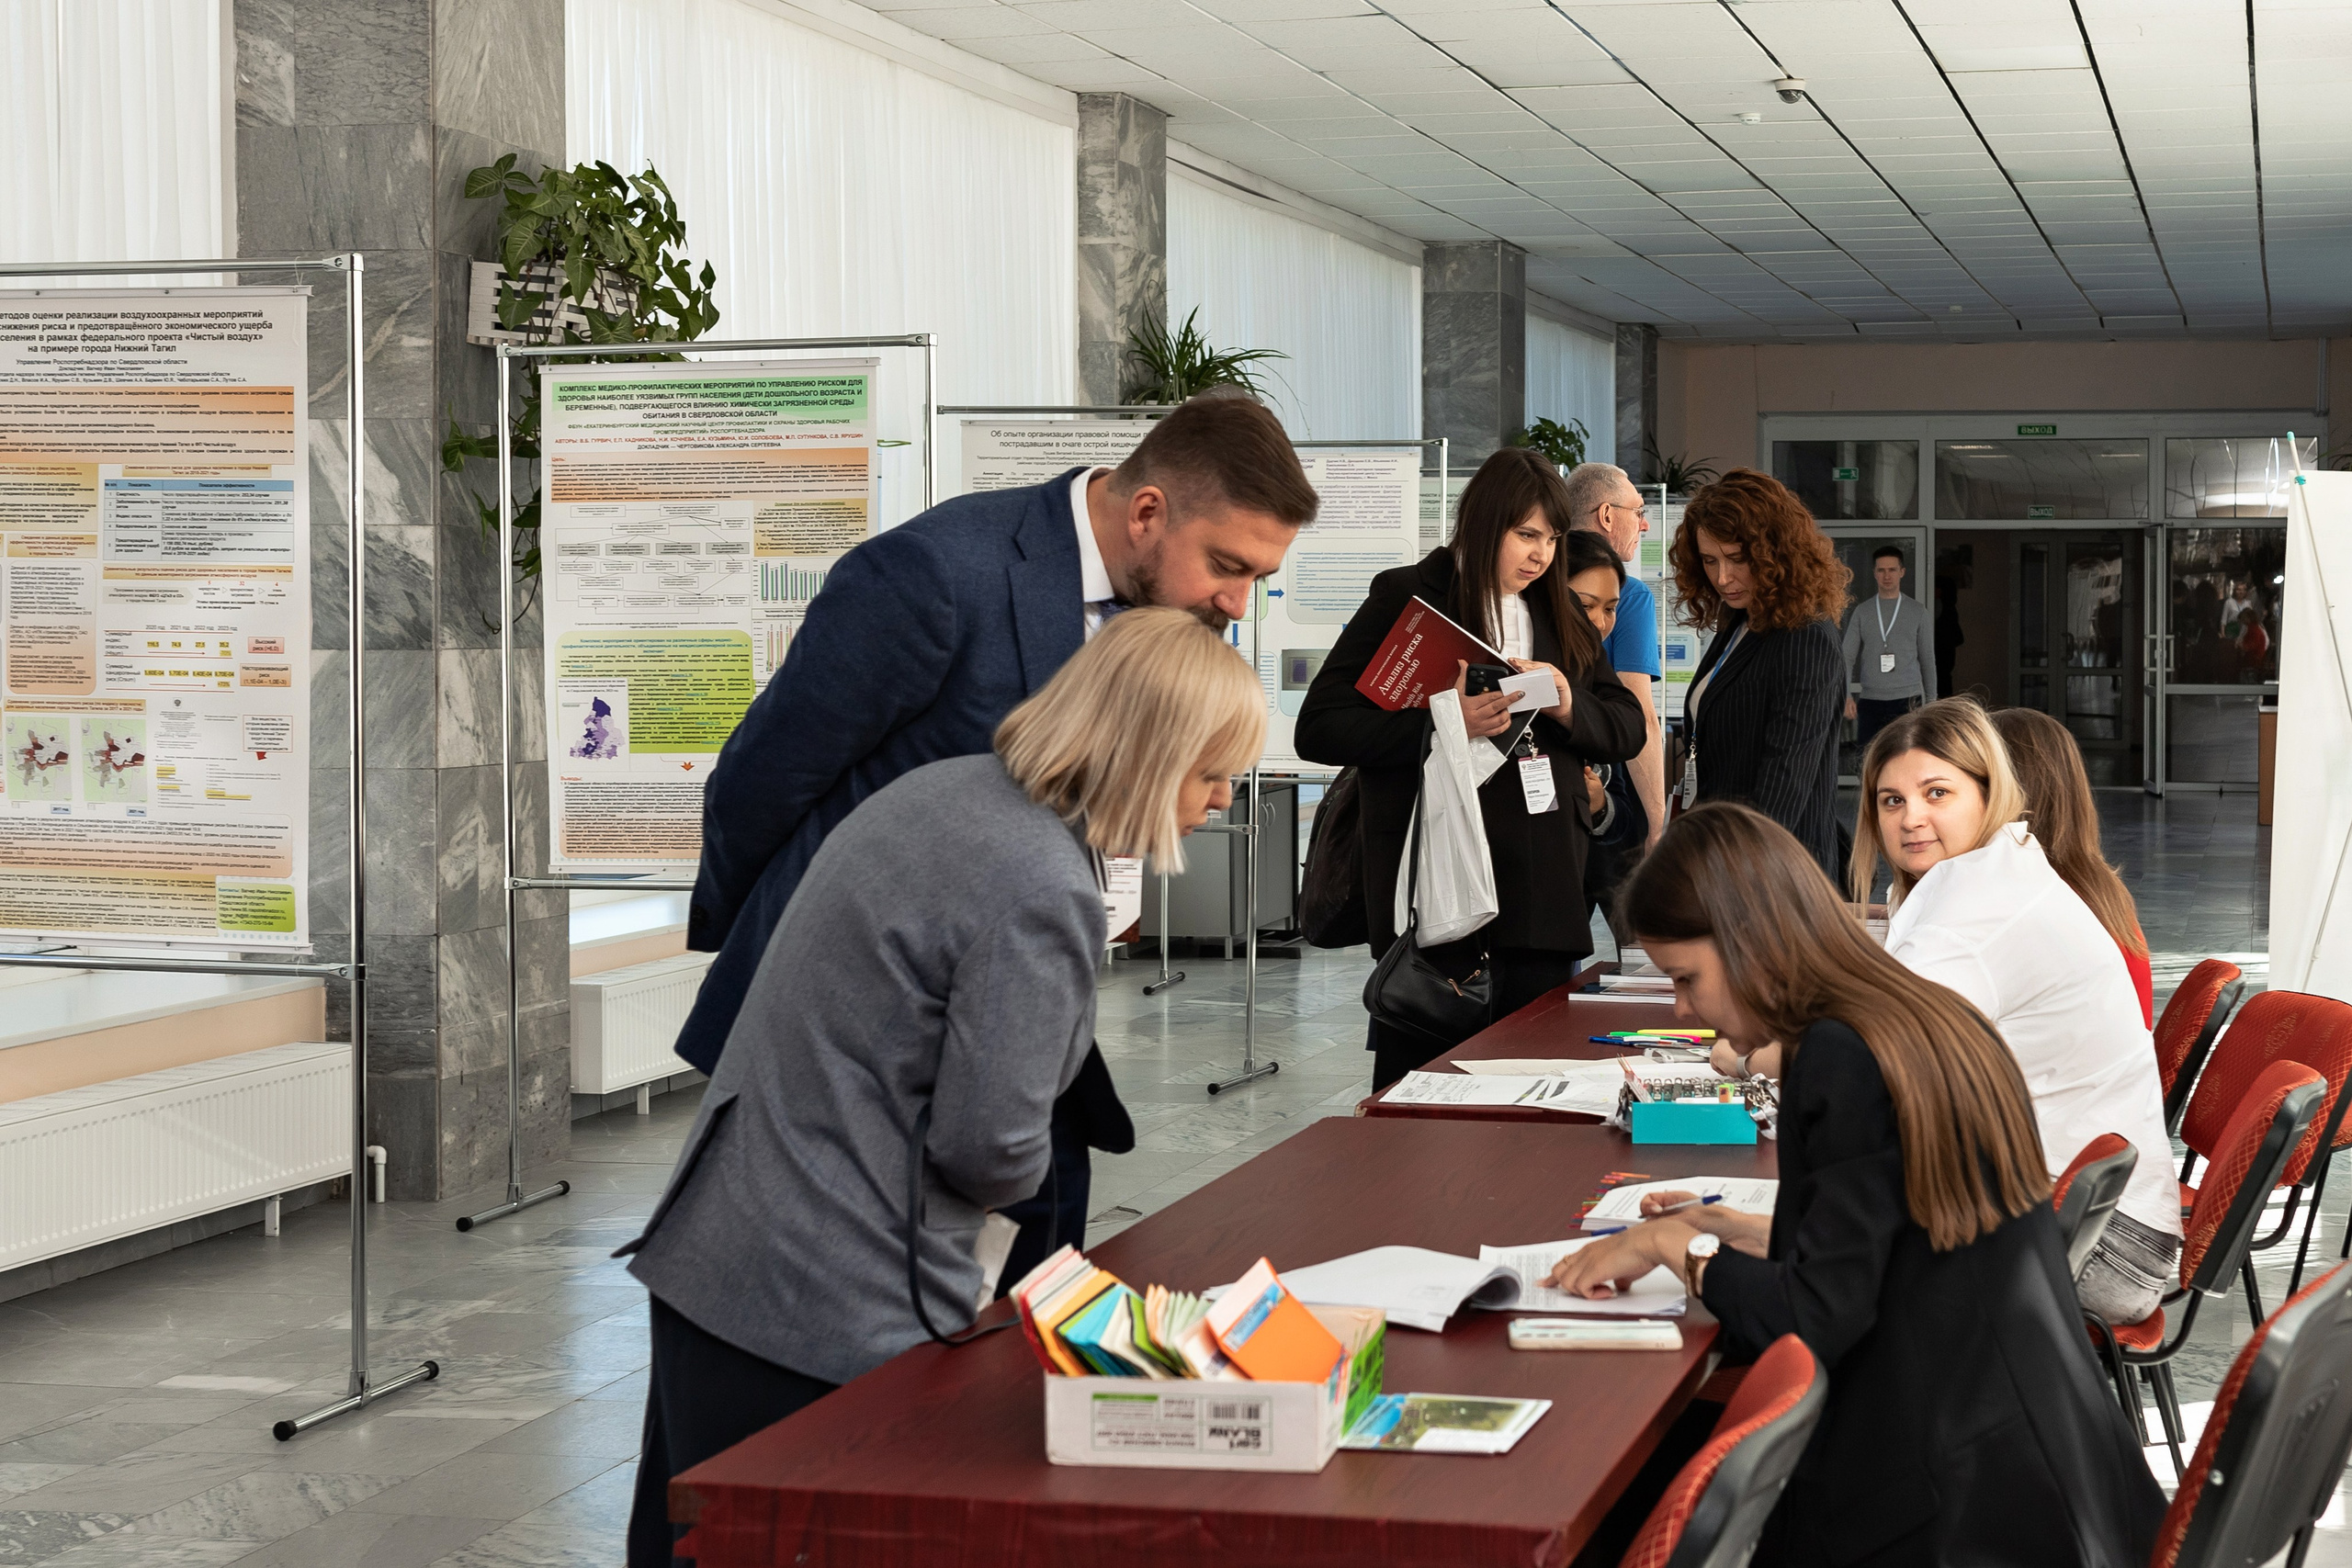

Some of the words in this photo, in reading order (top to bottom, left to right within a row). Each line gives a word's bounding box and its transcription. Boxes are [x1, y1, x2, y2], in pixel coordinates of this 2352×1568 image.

[32, 312, 63, 321] оценки
[65, 311, 118, 321] реализации
[120, 311, 200, 321] воздухоохранных
[203, 310, 264, 320] мероприятий
[42, 323, 67, 332] риска
[77, 321, 163, 332] предотвращённого
[164, 321, 237, 331] экономического
[239, 321, 273, 331] ущерба
[47, 334, 78, 344] рамках
[80, 333, 145, 344] федерального
[148, 333, 183, 343] проекта
[186, 332, 225, 341] «Чистый
[227, 333, 264, 343] воздух»
[40, 345, 79, 355] примере
[81, 345, 111, 355] города
[114, 343, 149, 352] Нижний
[151, 344, 176, 353] Тагил
[598, 383, 701, 391] МЕДИКО-ПРОФИЛАКТИЧЕСКИХ
[703, 380, 754, 389] МЕРОПРИЯТИЙ
[742, 390, 763, 399] (ДЕТИ
[764, 389, 818, 398] ДОШКОЛЬНОГО
[619, 402, 692, 411] ПОДВЕРГАЮЩЕГОСЯ
[693, 400, 729, 409] ВЛИЯНИЮ
[774, 399, 828, 407] ЗАГРЯЗНЕННОЙ
[688, 410, 743, 419] СВЕРДЛОВСКОЙ
[745, 410, 777, 418] ОБЛАСТИ
[990, 430, 1002, 438] Об
[1075, 431, 1110, 439] правовой
[2020, 426, 2053, 434] ВЫХОД
[1083, 440, 1109, 449] острой
[2029, 508, 2053, 516] ВЫХОД
[1378, 661, 1405, 695] Анализ
[1401, 633, 1423, 663] риска
[1389, 659, 1420, 703] здоровью
